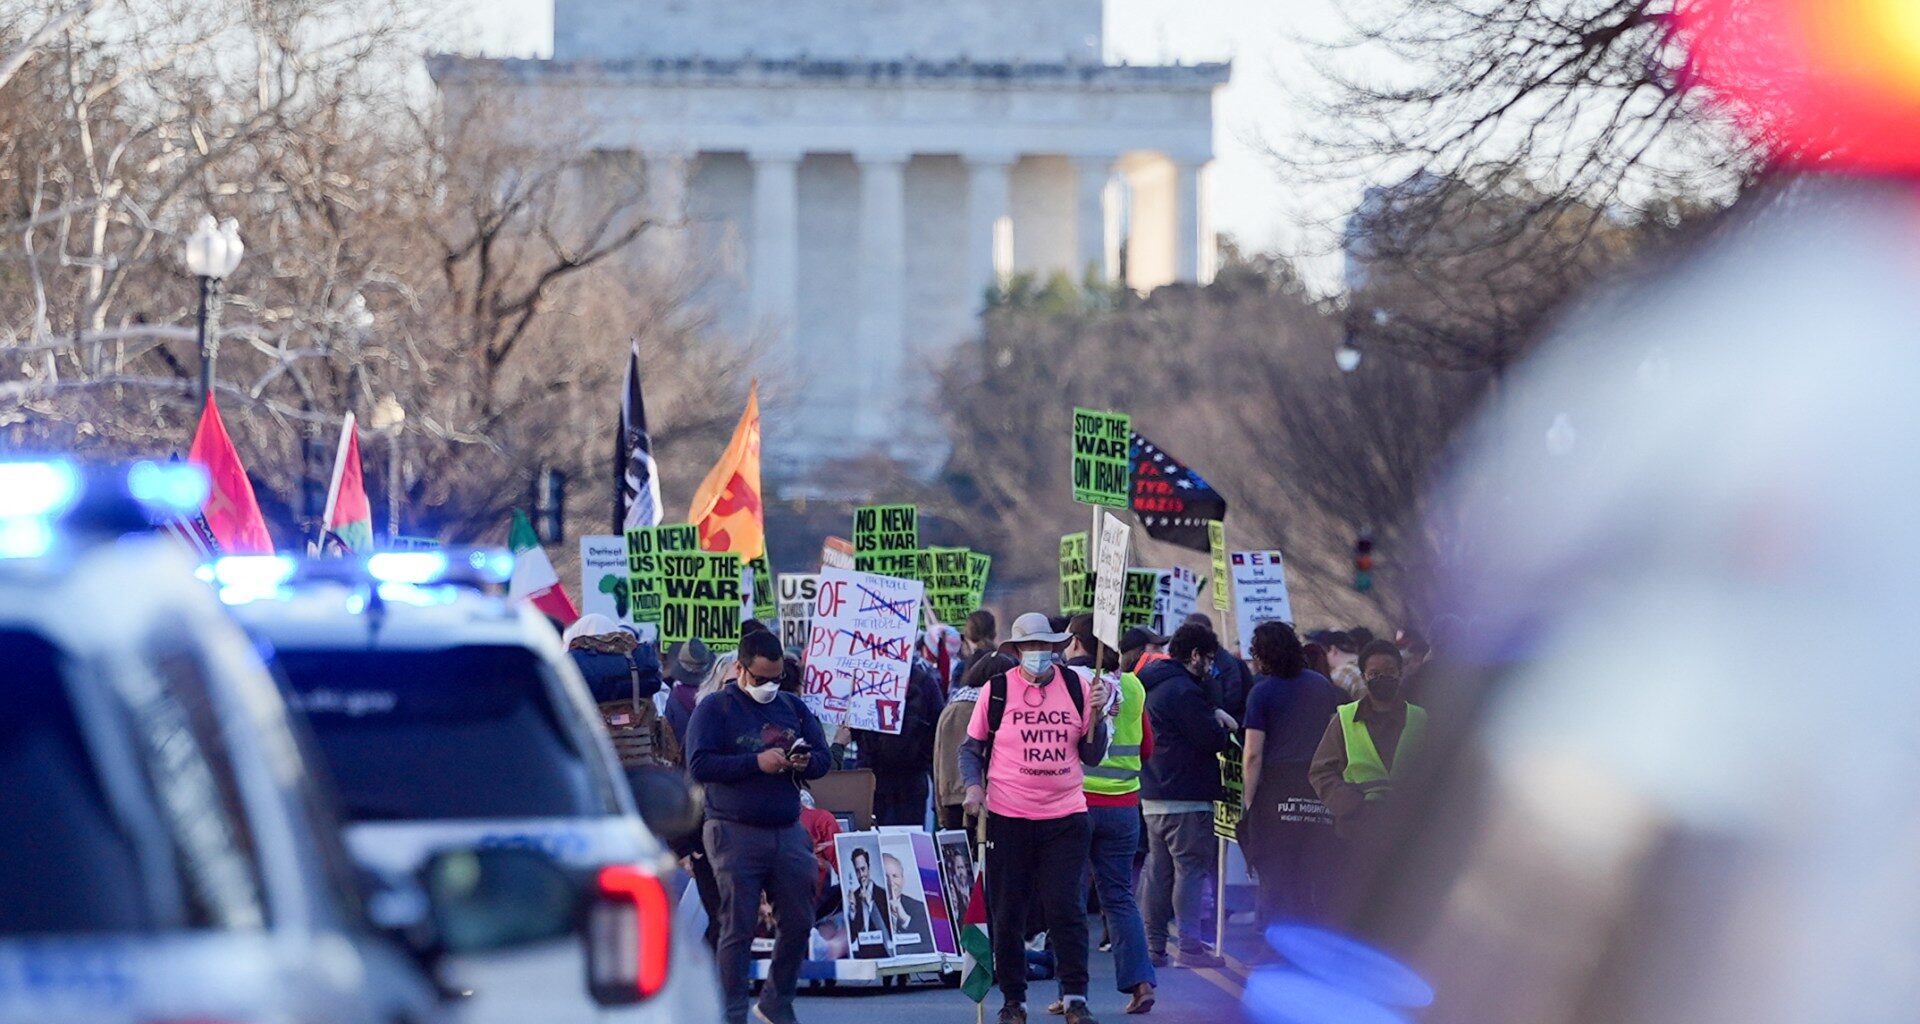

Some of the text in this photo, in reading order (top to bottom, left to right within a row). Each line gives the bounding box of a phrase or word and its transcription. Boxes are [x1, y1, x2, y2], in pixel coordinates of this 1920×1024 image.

[1075, 414, 1127, 438] STOP THE
[1075, 435, 1126, 459] WAR
[1075, 457, 1090, 490] ON
[1095, 461, 1127, 495] IRAN!
[857, 508, 914, 533] NO NEW
[627, 527, 697, 555] NO NEW
[856, 533, 915, 551] US WAR
[587, 558, 627, 569] Imperial
[629, 555, 654, 572] US
[664, 556, 705, 578] STOP
[709, 556, 739, 578] THE
[855, 555, 915, 571] IN THE
[632, 578, 653, 593] IN
[664, 578, 739, 600] WAR
[782, 578, 817, 600] US
[1126, 573, 1155, 593] EW
[818, 581, 848, 618] OF
[936, 594, 967, 606] THE
[1124, 594, 1152, 609] AR
[663, 603, 739, 639] ON IRAN!
[1121, 612, 1150, 625] HE
[810, 627, 841, 657] BY
[1013, 710, 1072, 725] PEACE
[1020, 729, 1068, 743] WITH
[1023, 748, 1066, 762] IRAN
[1019, 767, 1071, 776] CODEPINK.ORG
[1277, 803, 1331, 814] FUJI MOUNTA
